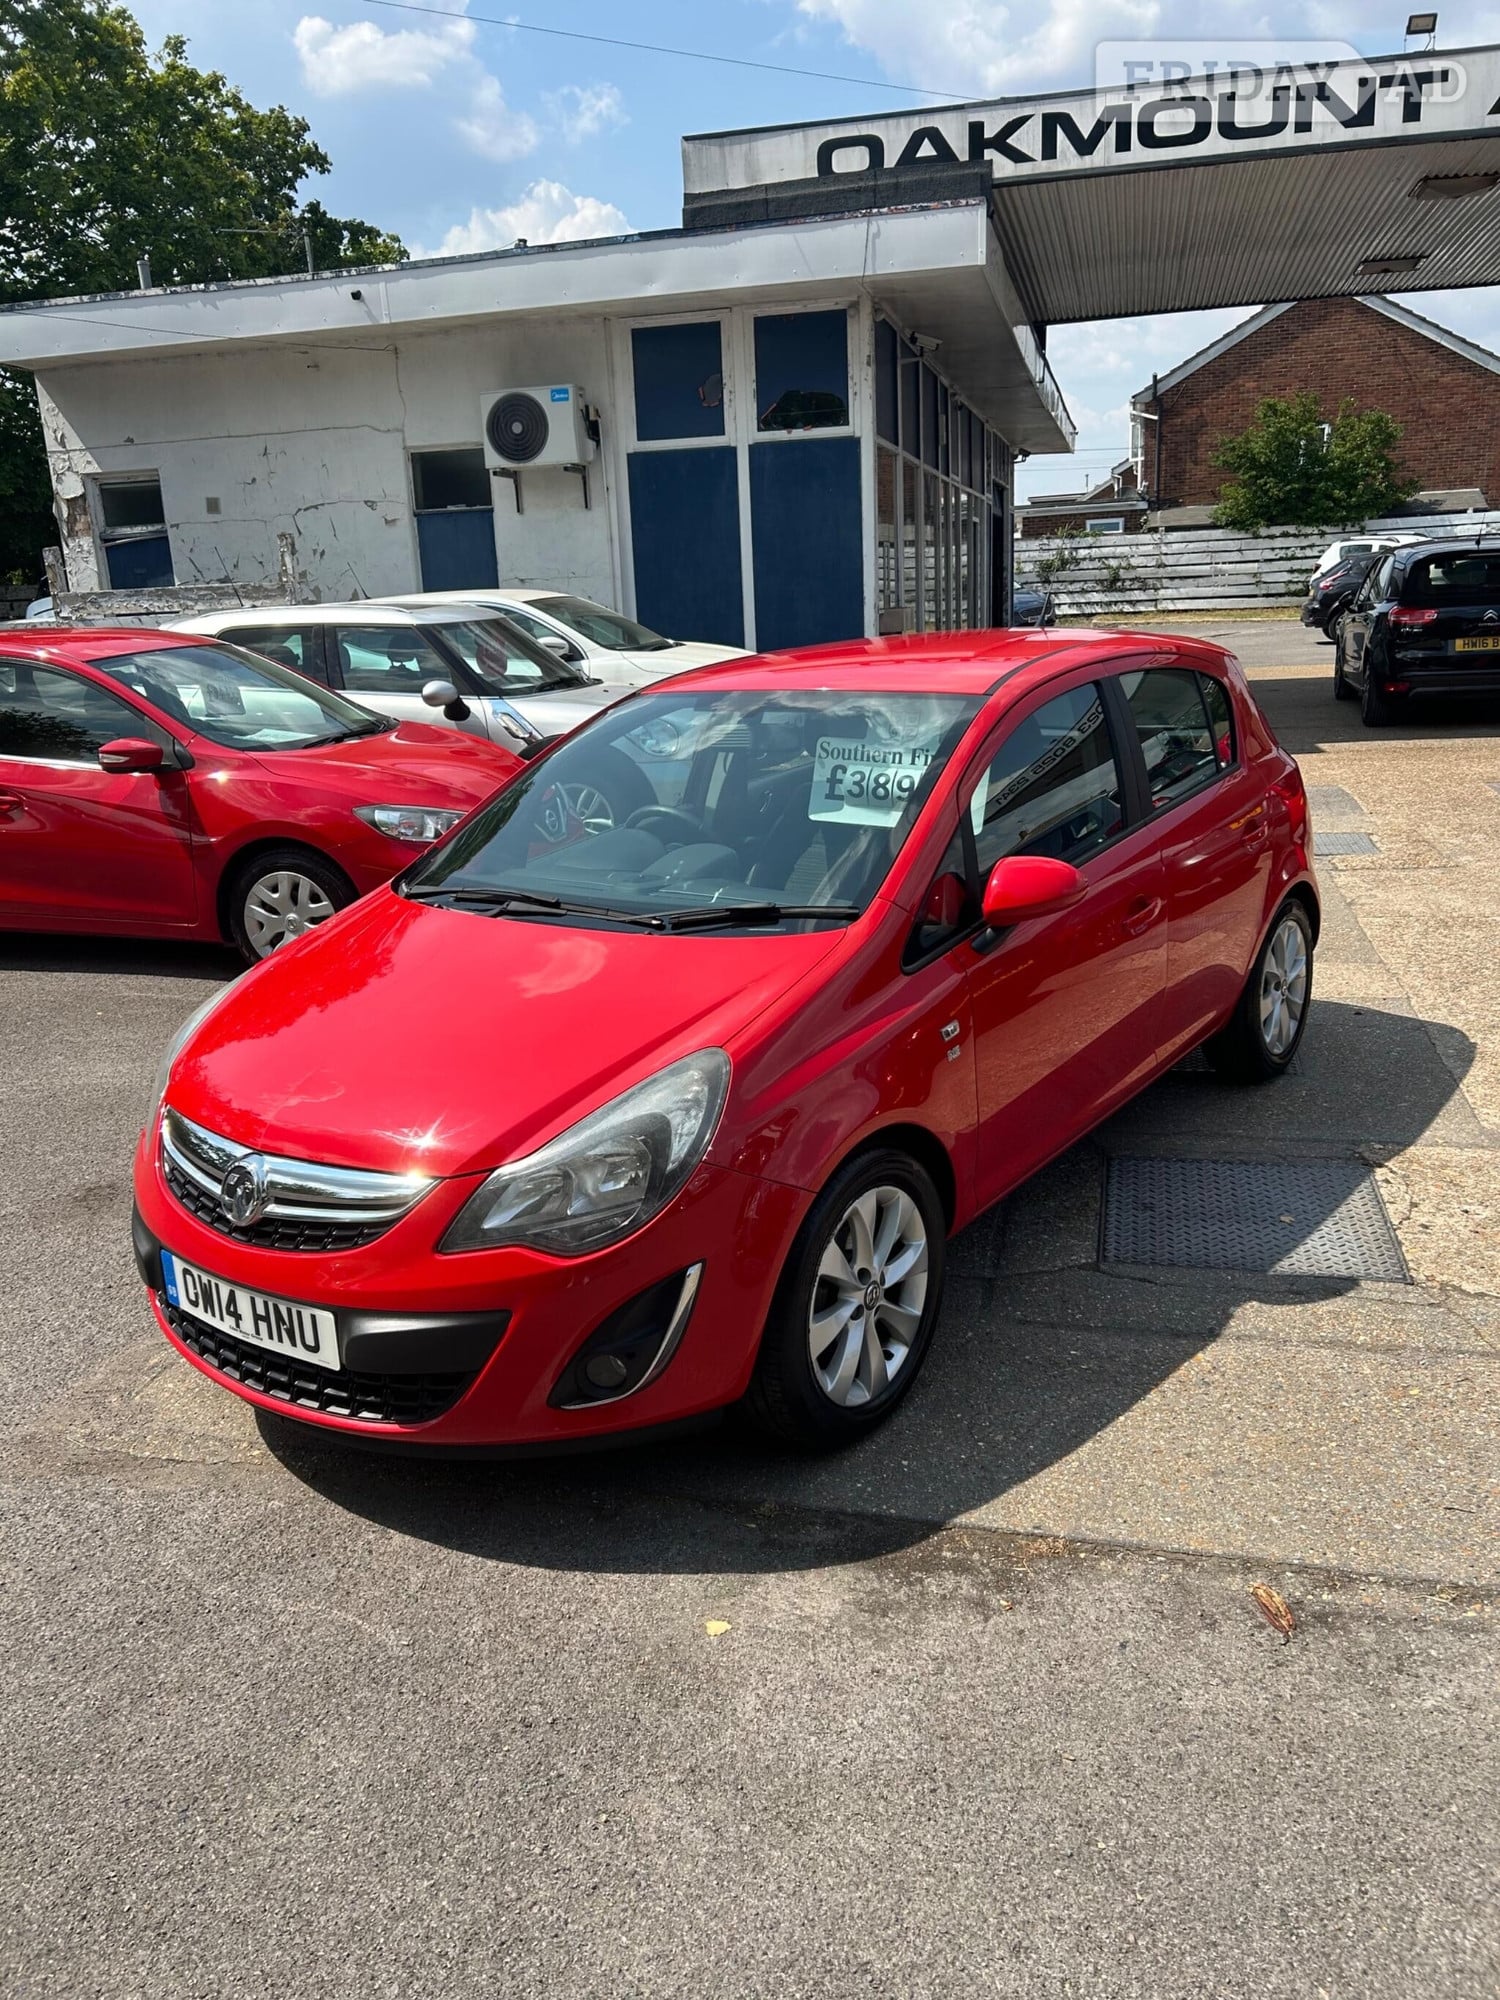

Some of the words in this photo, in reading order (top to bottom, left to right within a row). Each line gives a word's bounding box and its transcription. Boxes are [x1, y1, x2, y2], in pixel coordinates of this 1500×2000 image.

[816, 69, 1450, 178] OAKMOUNT
[1463, 638, 1489, 649] HW16
[818, 740, 903, 765] Southern
[911, 748, 935, 767] Fi
[250, 1295, 321, 1355] HNU
